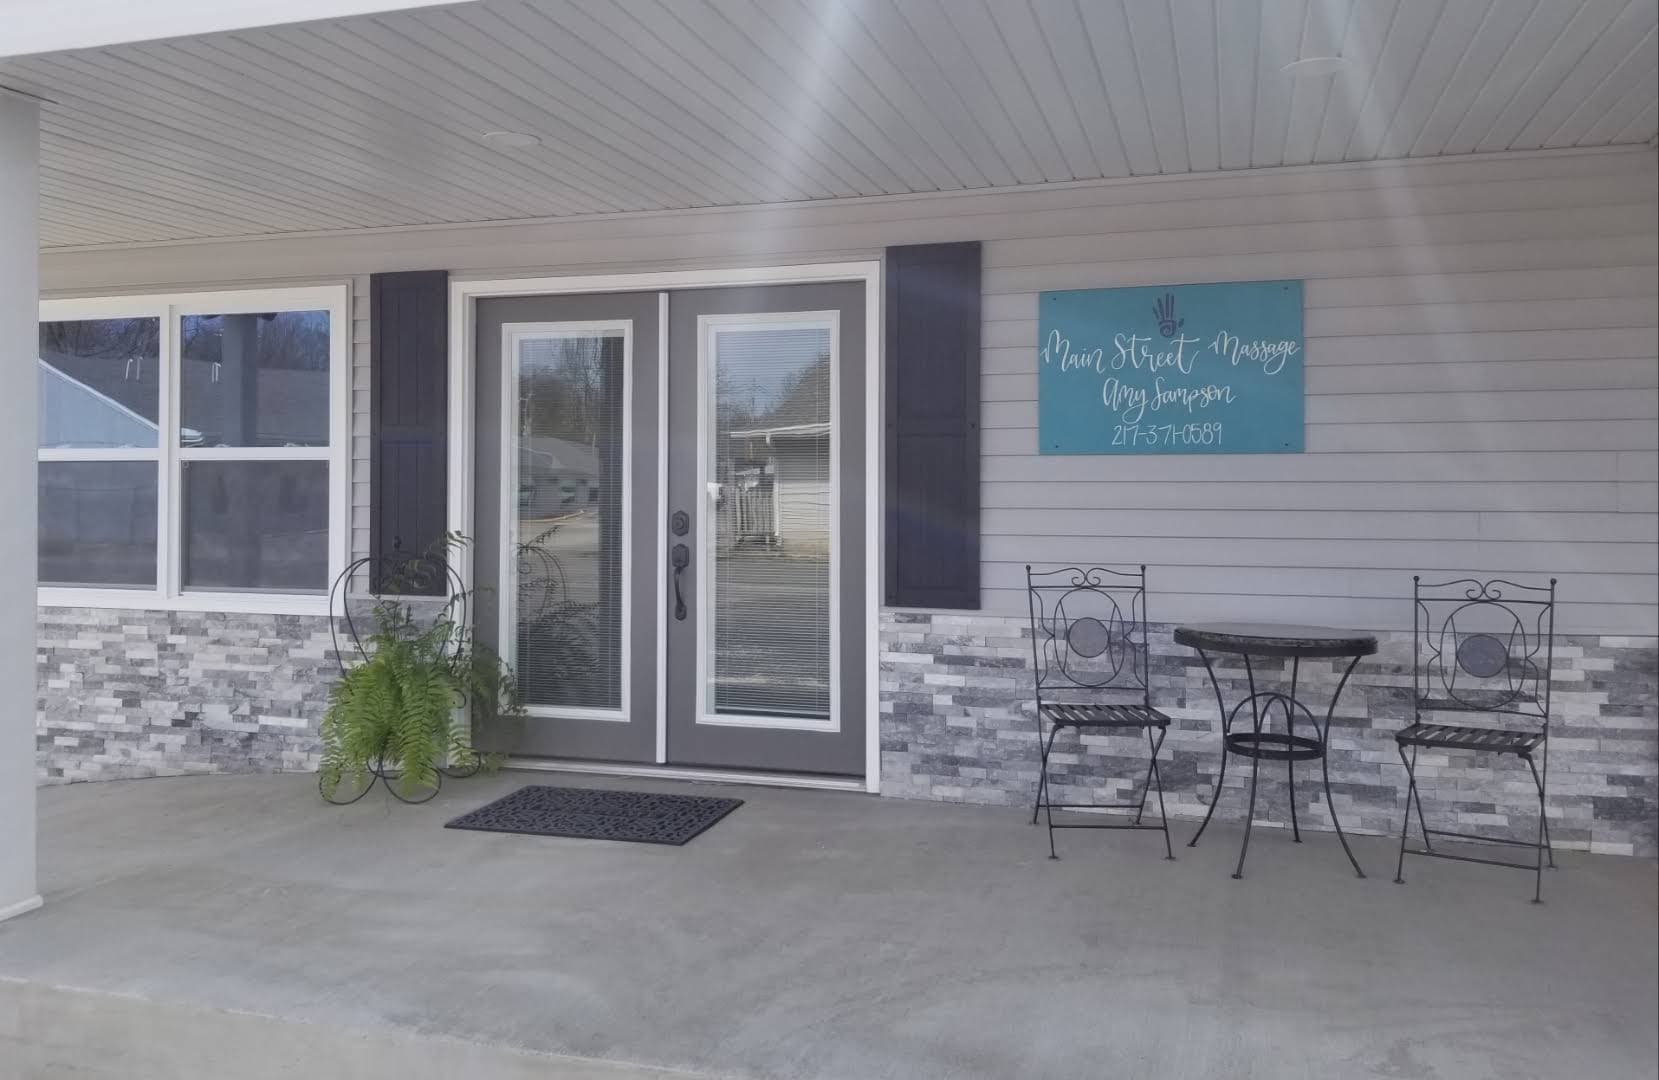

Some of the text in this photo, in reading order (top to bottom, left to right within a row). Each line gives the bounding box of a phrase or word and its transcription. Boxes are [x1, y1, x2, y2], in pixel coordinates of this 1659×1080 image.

[1040, 329, 1301, 375] Main Street Massage
[1102, 376, 1236, 425] Amy Sampson
[1111, 422, 1223, 446] 217-371-0589
